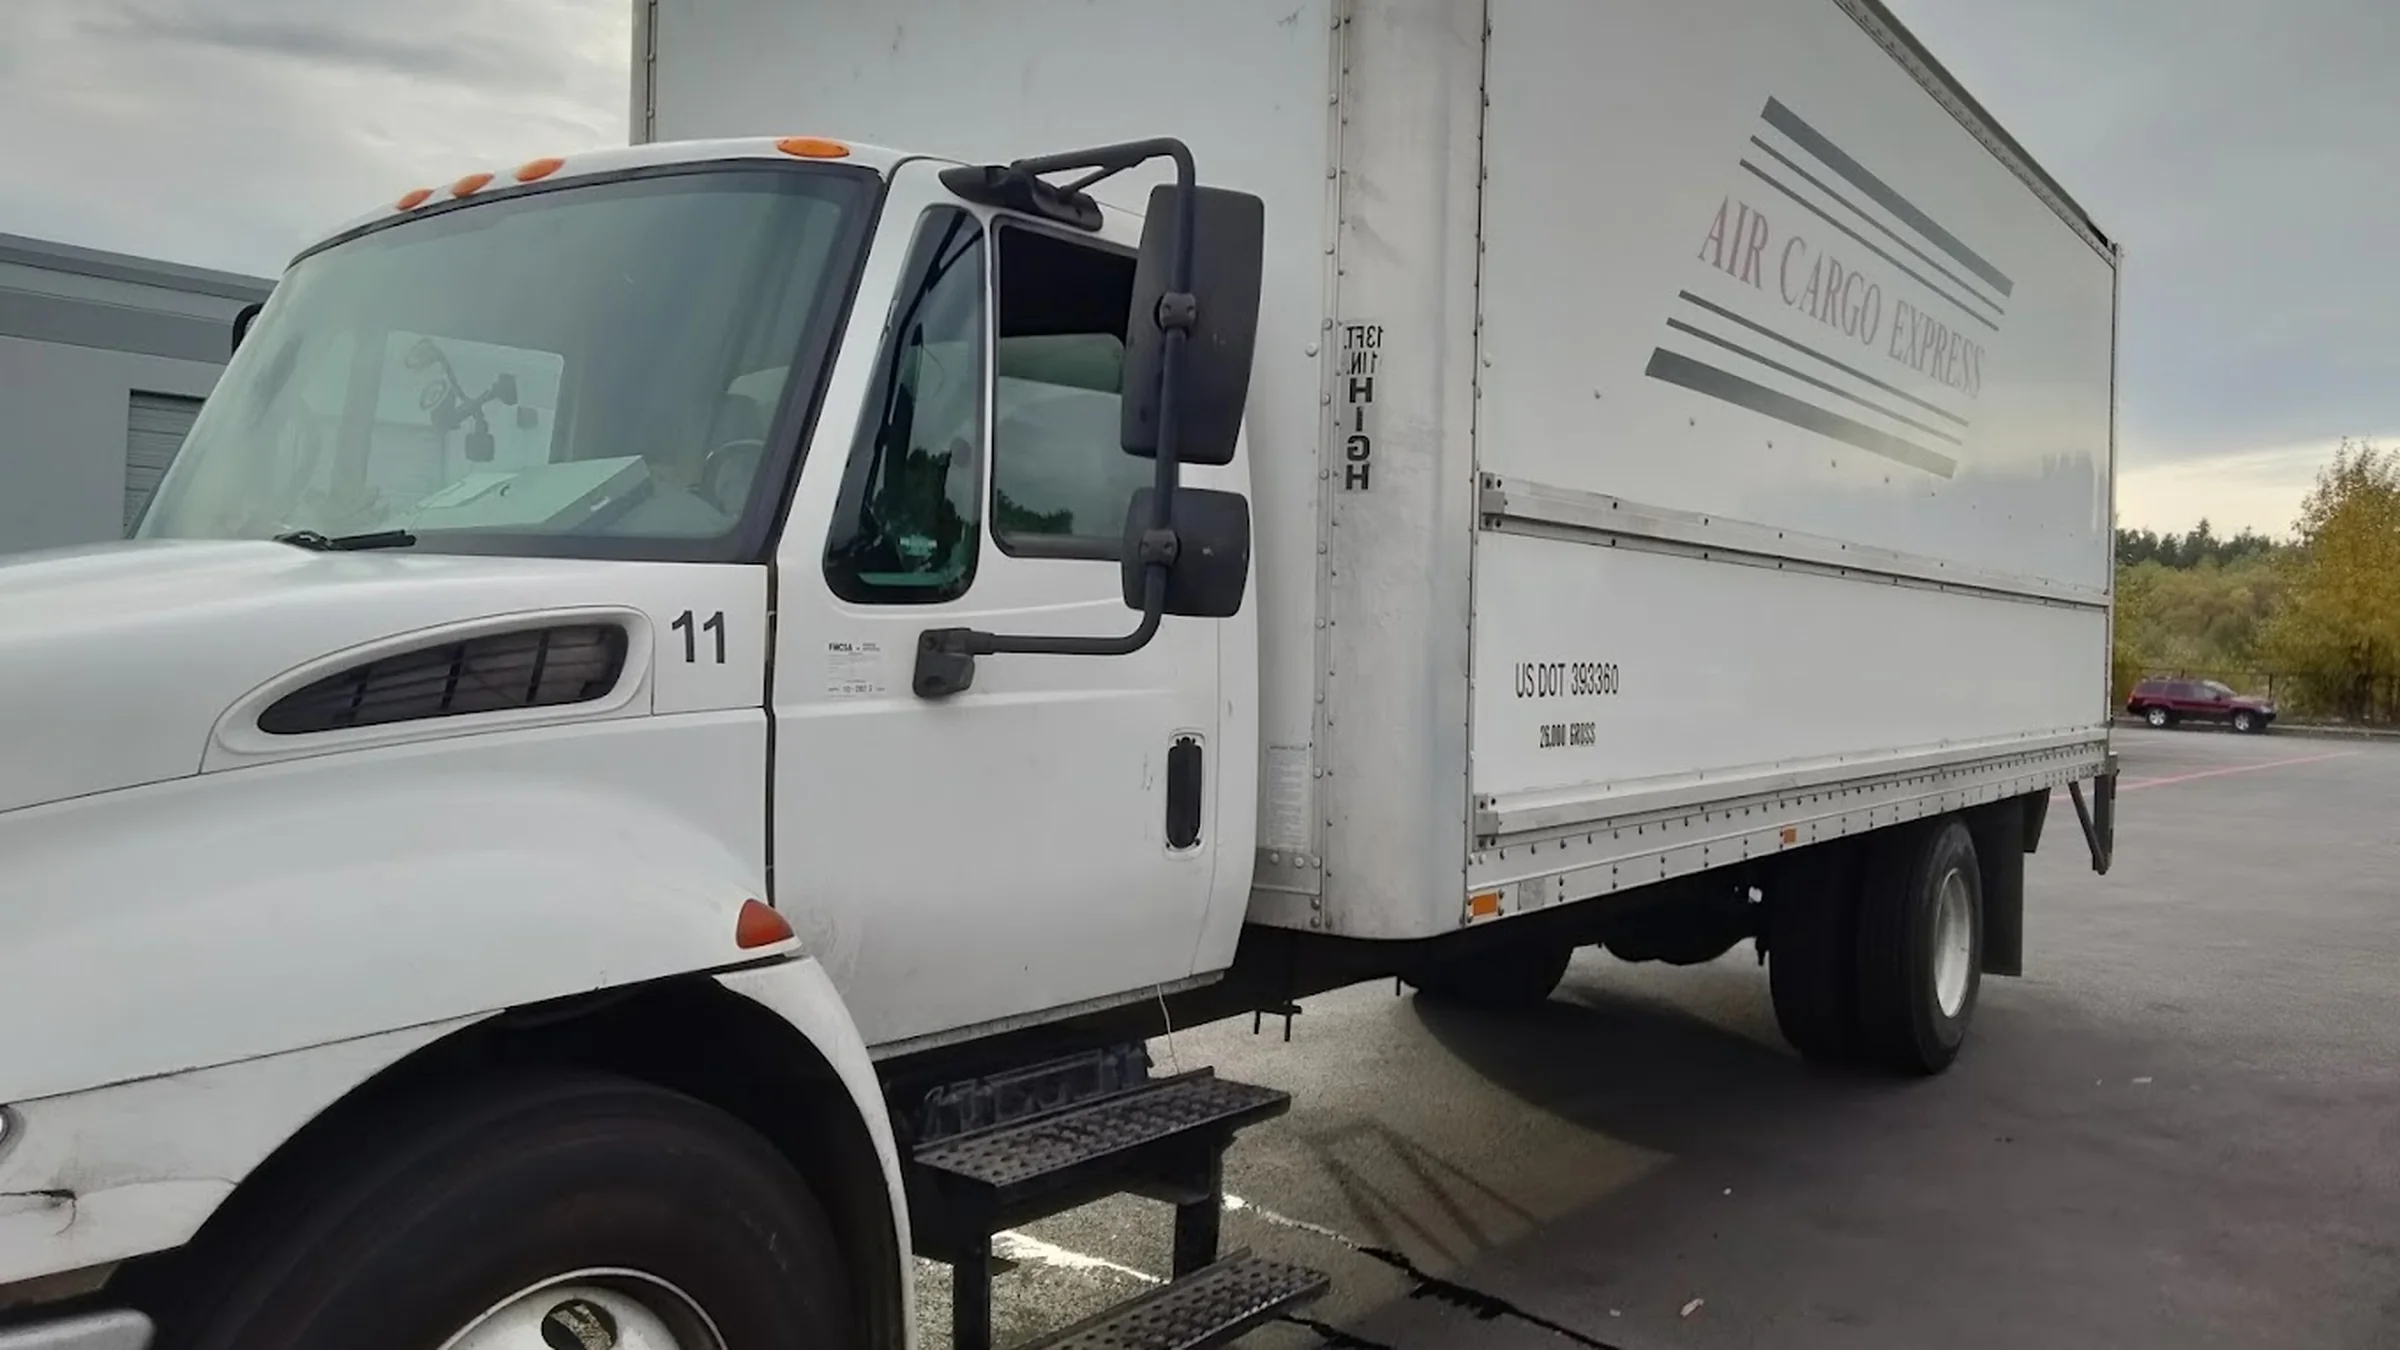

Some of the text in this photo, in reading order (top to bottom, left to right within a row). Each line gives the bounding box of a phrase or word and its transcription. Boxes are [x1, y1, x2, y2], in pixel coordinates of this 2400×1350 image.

[1697, 195, 1986, 400] AIR CARGO EXPRESS
[671, 610, 726, 664] 11
[1515, 662, 1619, 698] US DOT 393360
